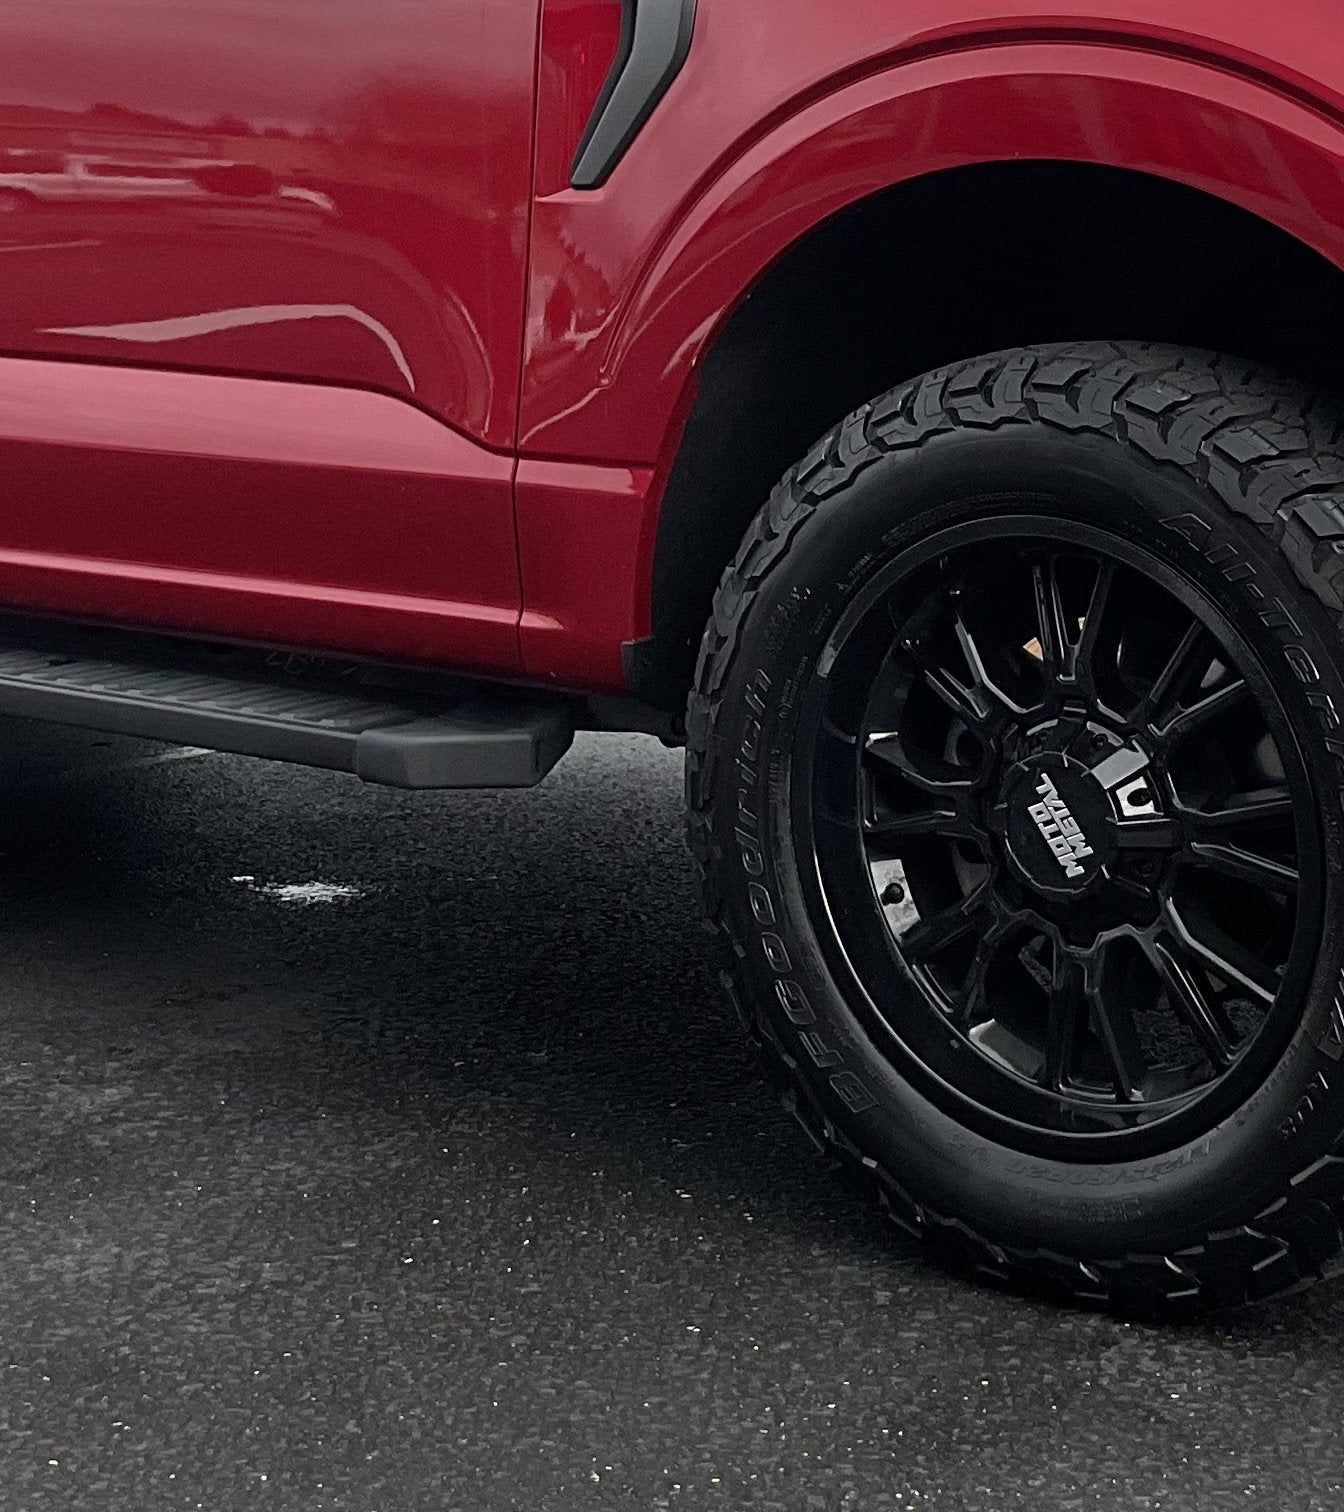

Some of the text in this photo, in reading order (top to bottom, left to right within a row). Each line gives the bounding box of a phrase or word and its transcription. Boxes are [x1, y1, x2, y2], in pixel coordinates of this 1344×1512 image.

[1027, 801, 1086, 879] MOTO
[1035, 772, 1094, 860] METAL
[733, 667, 882, 1115] BFGoodrich
